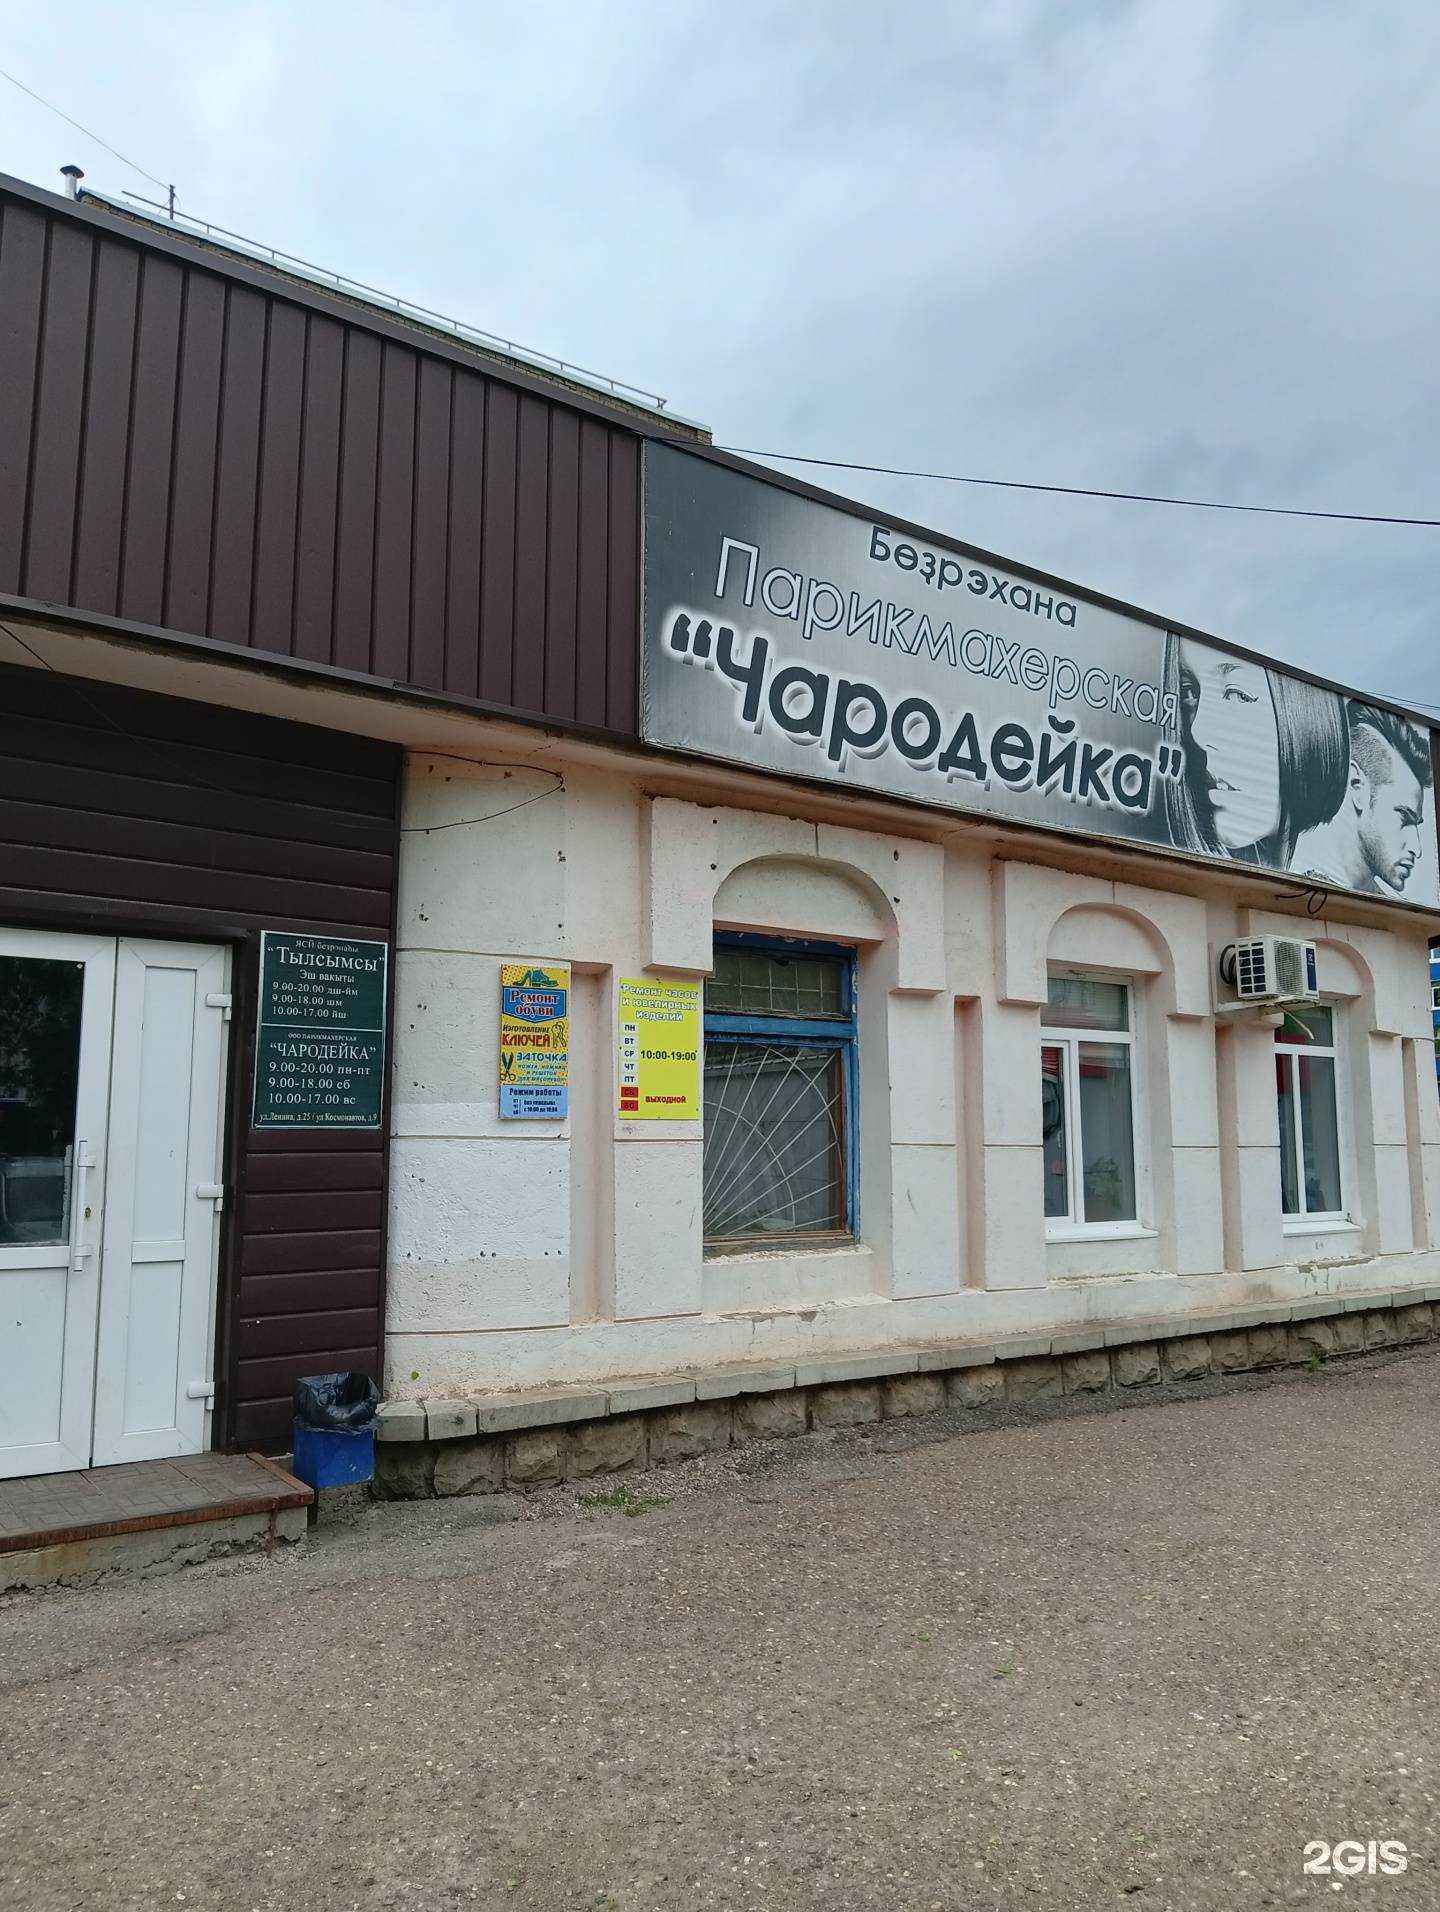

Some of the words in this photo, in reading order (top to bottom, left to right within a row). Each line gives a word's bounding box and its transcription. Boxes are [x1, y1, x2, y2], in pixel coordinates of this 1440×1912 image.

[714, 536, 1178, 730] Парикмахерская
[272, 982, 325, 994] 9.00-20.00
[622, 983, 662, 996] Ремонт
[665, 989, 698, 1000] часов
[272, 994, 324, 1006] 9.00-18.00
[633, 1000, 697, 1012] ювелирных
[635, 1010, 684, 1022] изделий
[516, 1052, 567, 1062] ЗАТОЧКА
[640, 1050, 697, 1061] 10:00-19:00
[269, 1062, 334, 1074] 9.00-20.00
[337, 1067, 371, 1076] пн-пт
[268, 1077, 333, 1089] 9.00-18.00
[336, 1079, 351, 1090] сб
[269, 1093, 339, 1105] 10.00-17.00
[343, 1097, 357, 1106] вс
